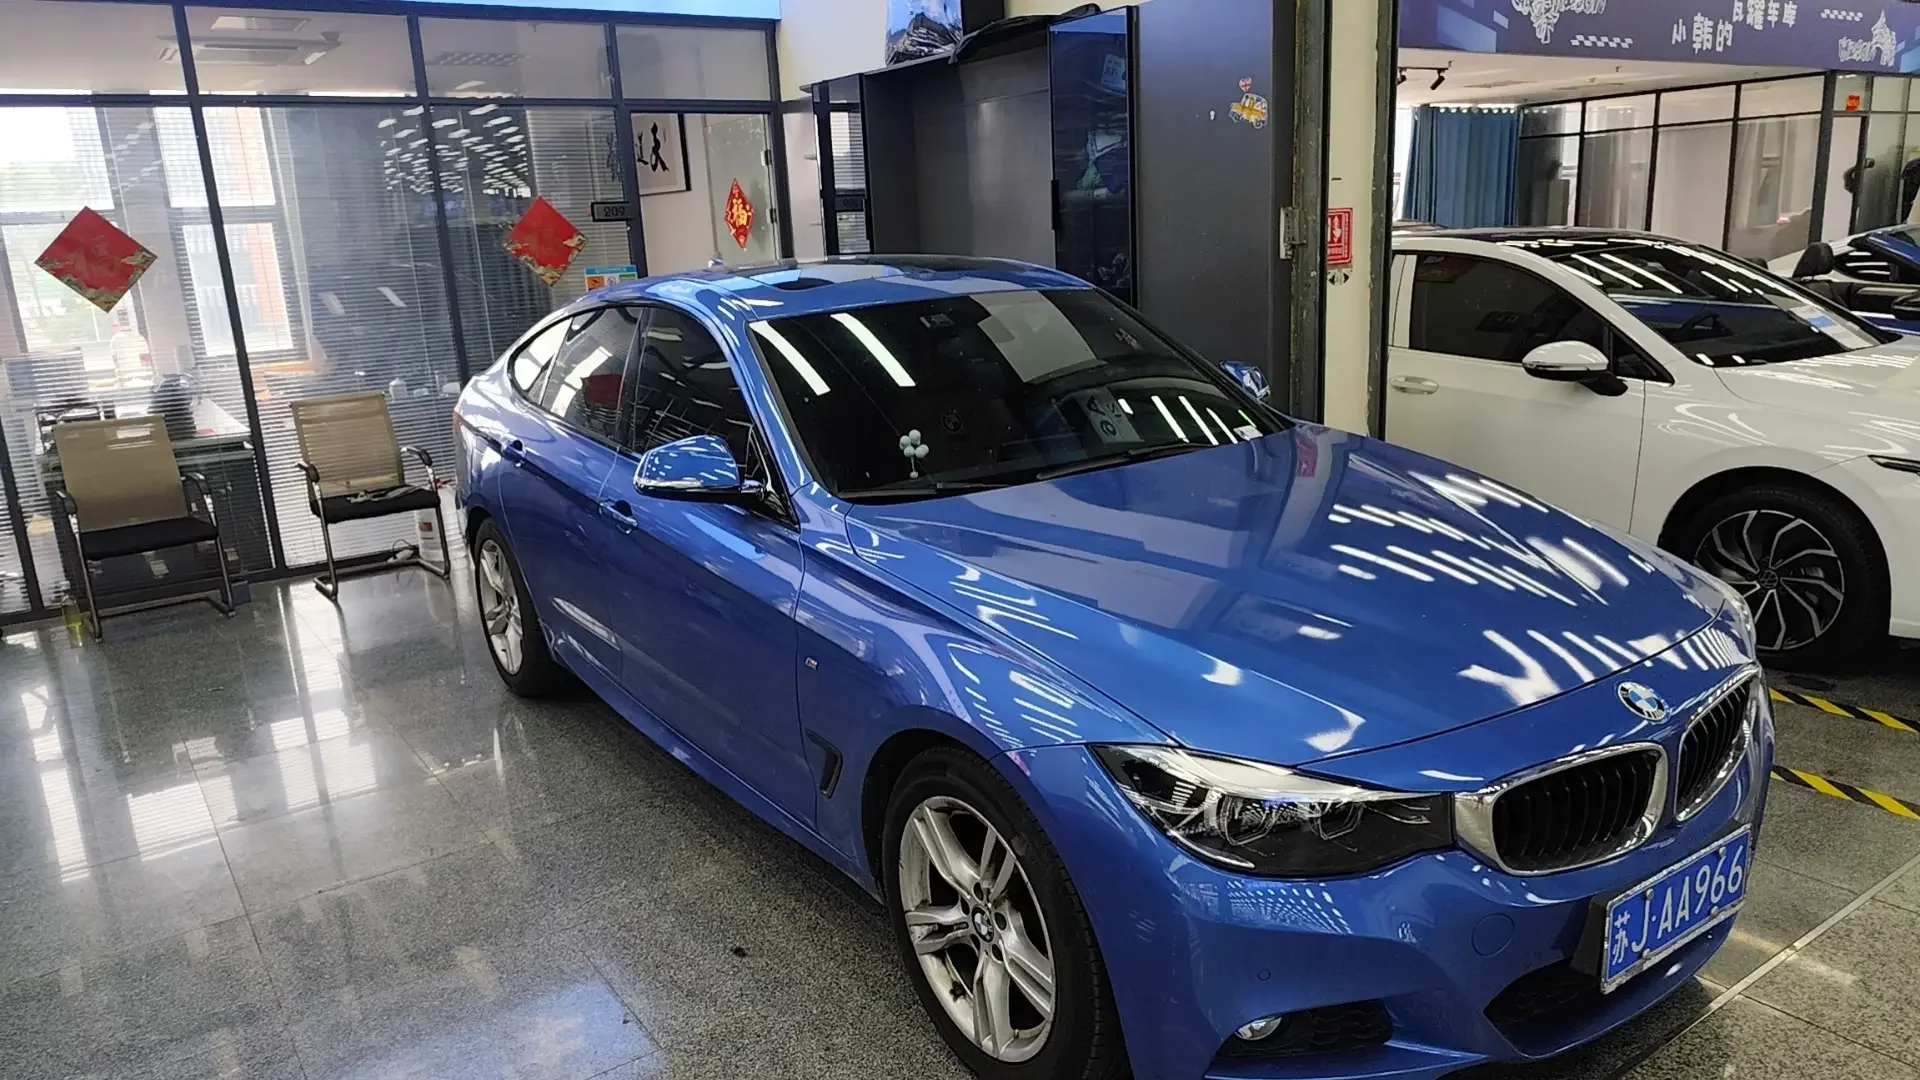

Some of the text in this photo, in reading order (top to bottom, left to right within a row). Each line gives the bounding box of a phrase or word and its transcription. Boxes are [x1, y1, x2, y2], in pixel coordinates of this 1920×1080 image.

[1672, 12, 1733, 54] 小韩的
[603, 206, 626, 217] 209
